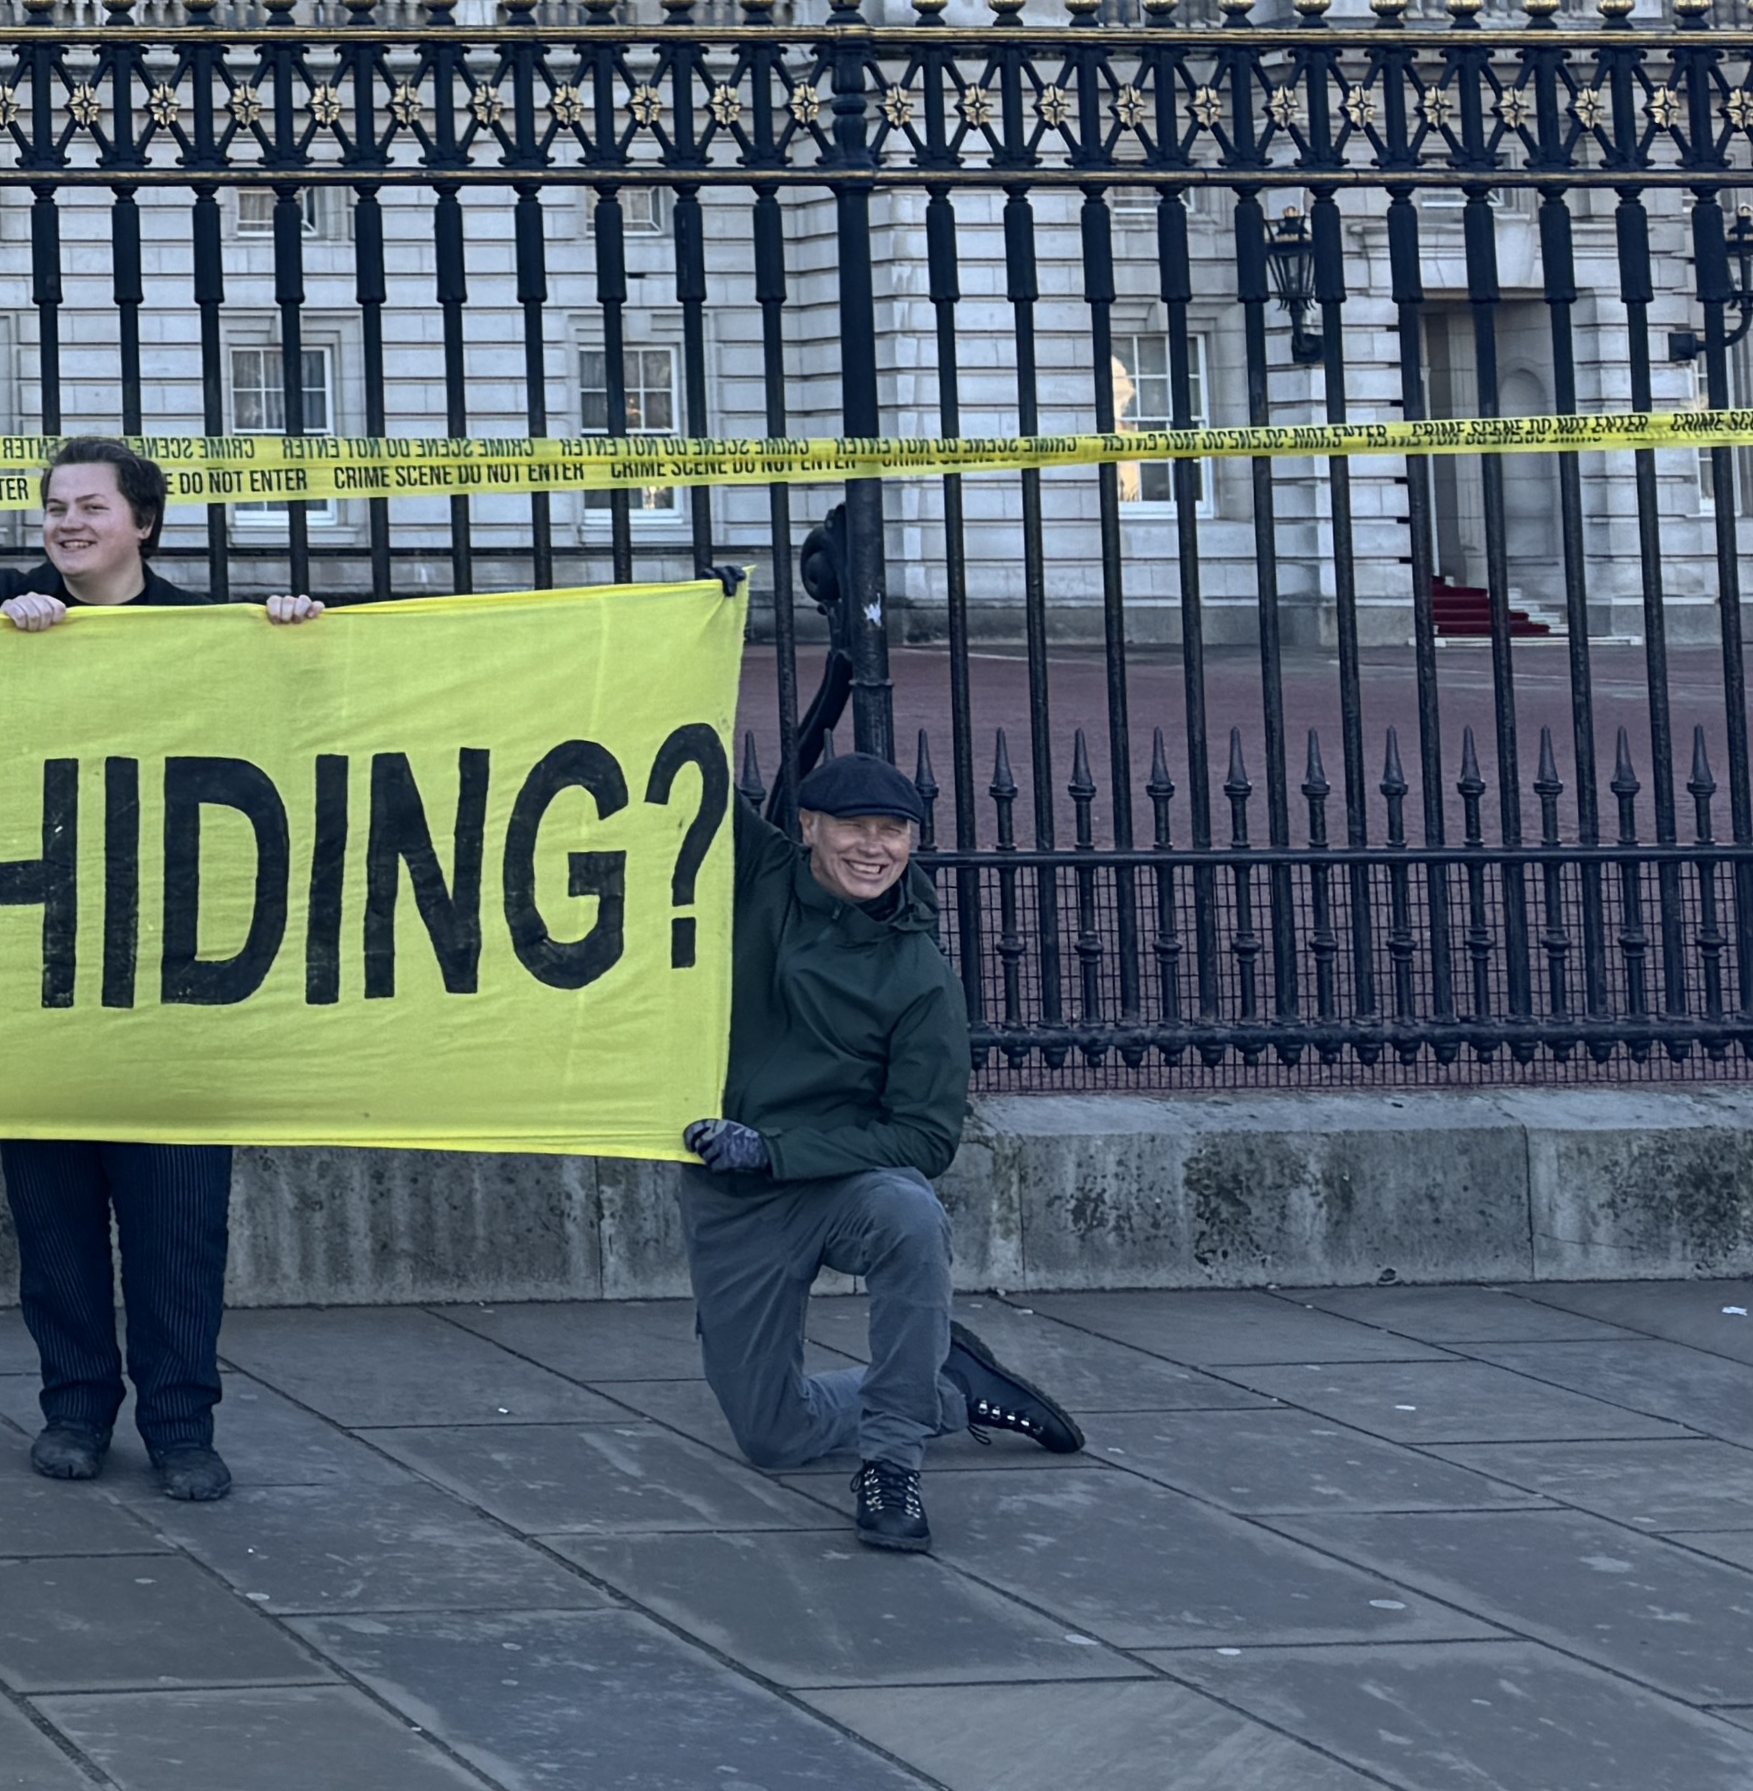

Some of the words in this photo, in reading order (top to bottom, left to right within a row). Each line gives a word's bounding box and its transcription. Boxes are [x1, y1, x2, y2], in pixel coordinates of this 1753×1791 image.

[1593, 415, 1648, 432] ENTER
[1671, 413, 1726, 431] CRIME
[181, 473, 202, 494] DO
[210, 471, 242, 493] NOT
[250, 469, 306, 492] ENTER
[335, 467, 390, 489] CRIME
[396, 466, 451, 487] SCENE
